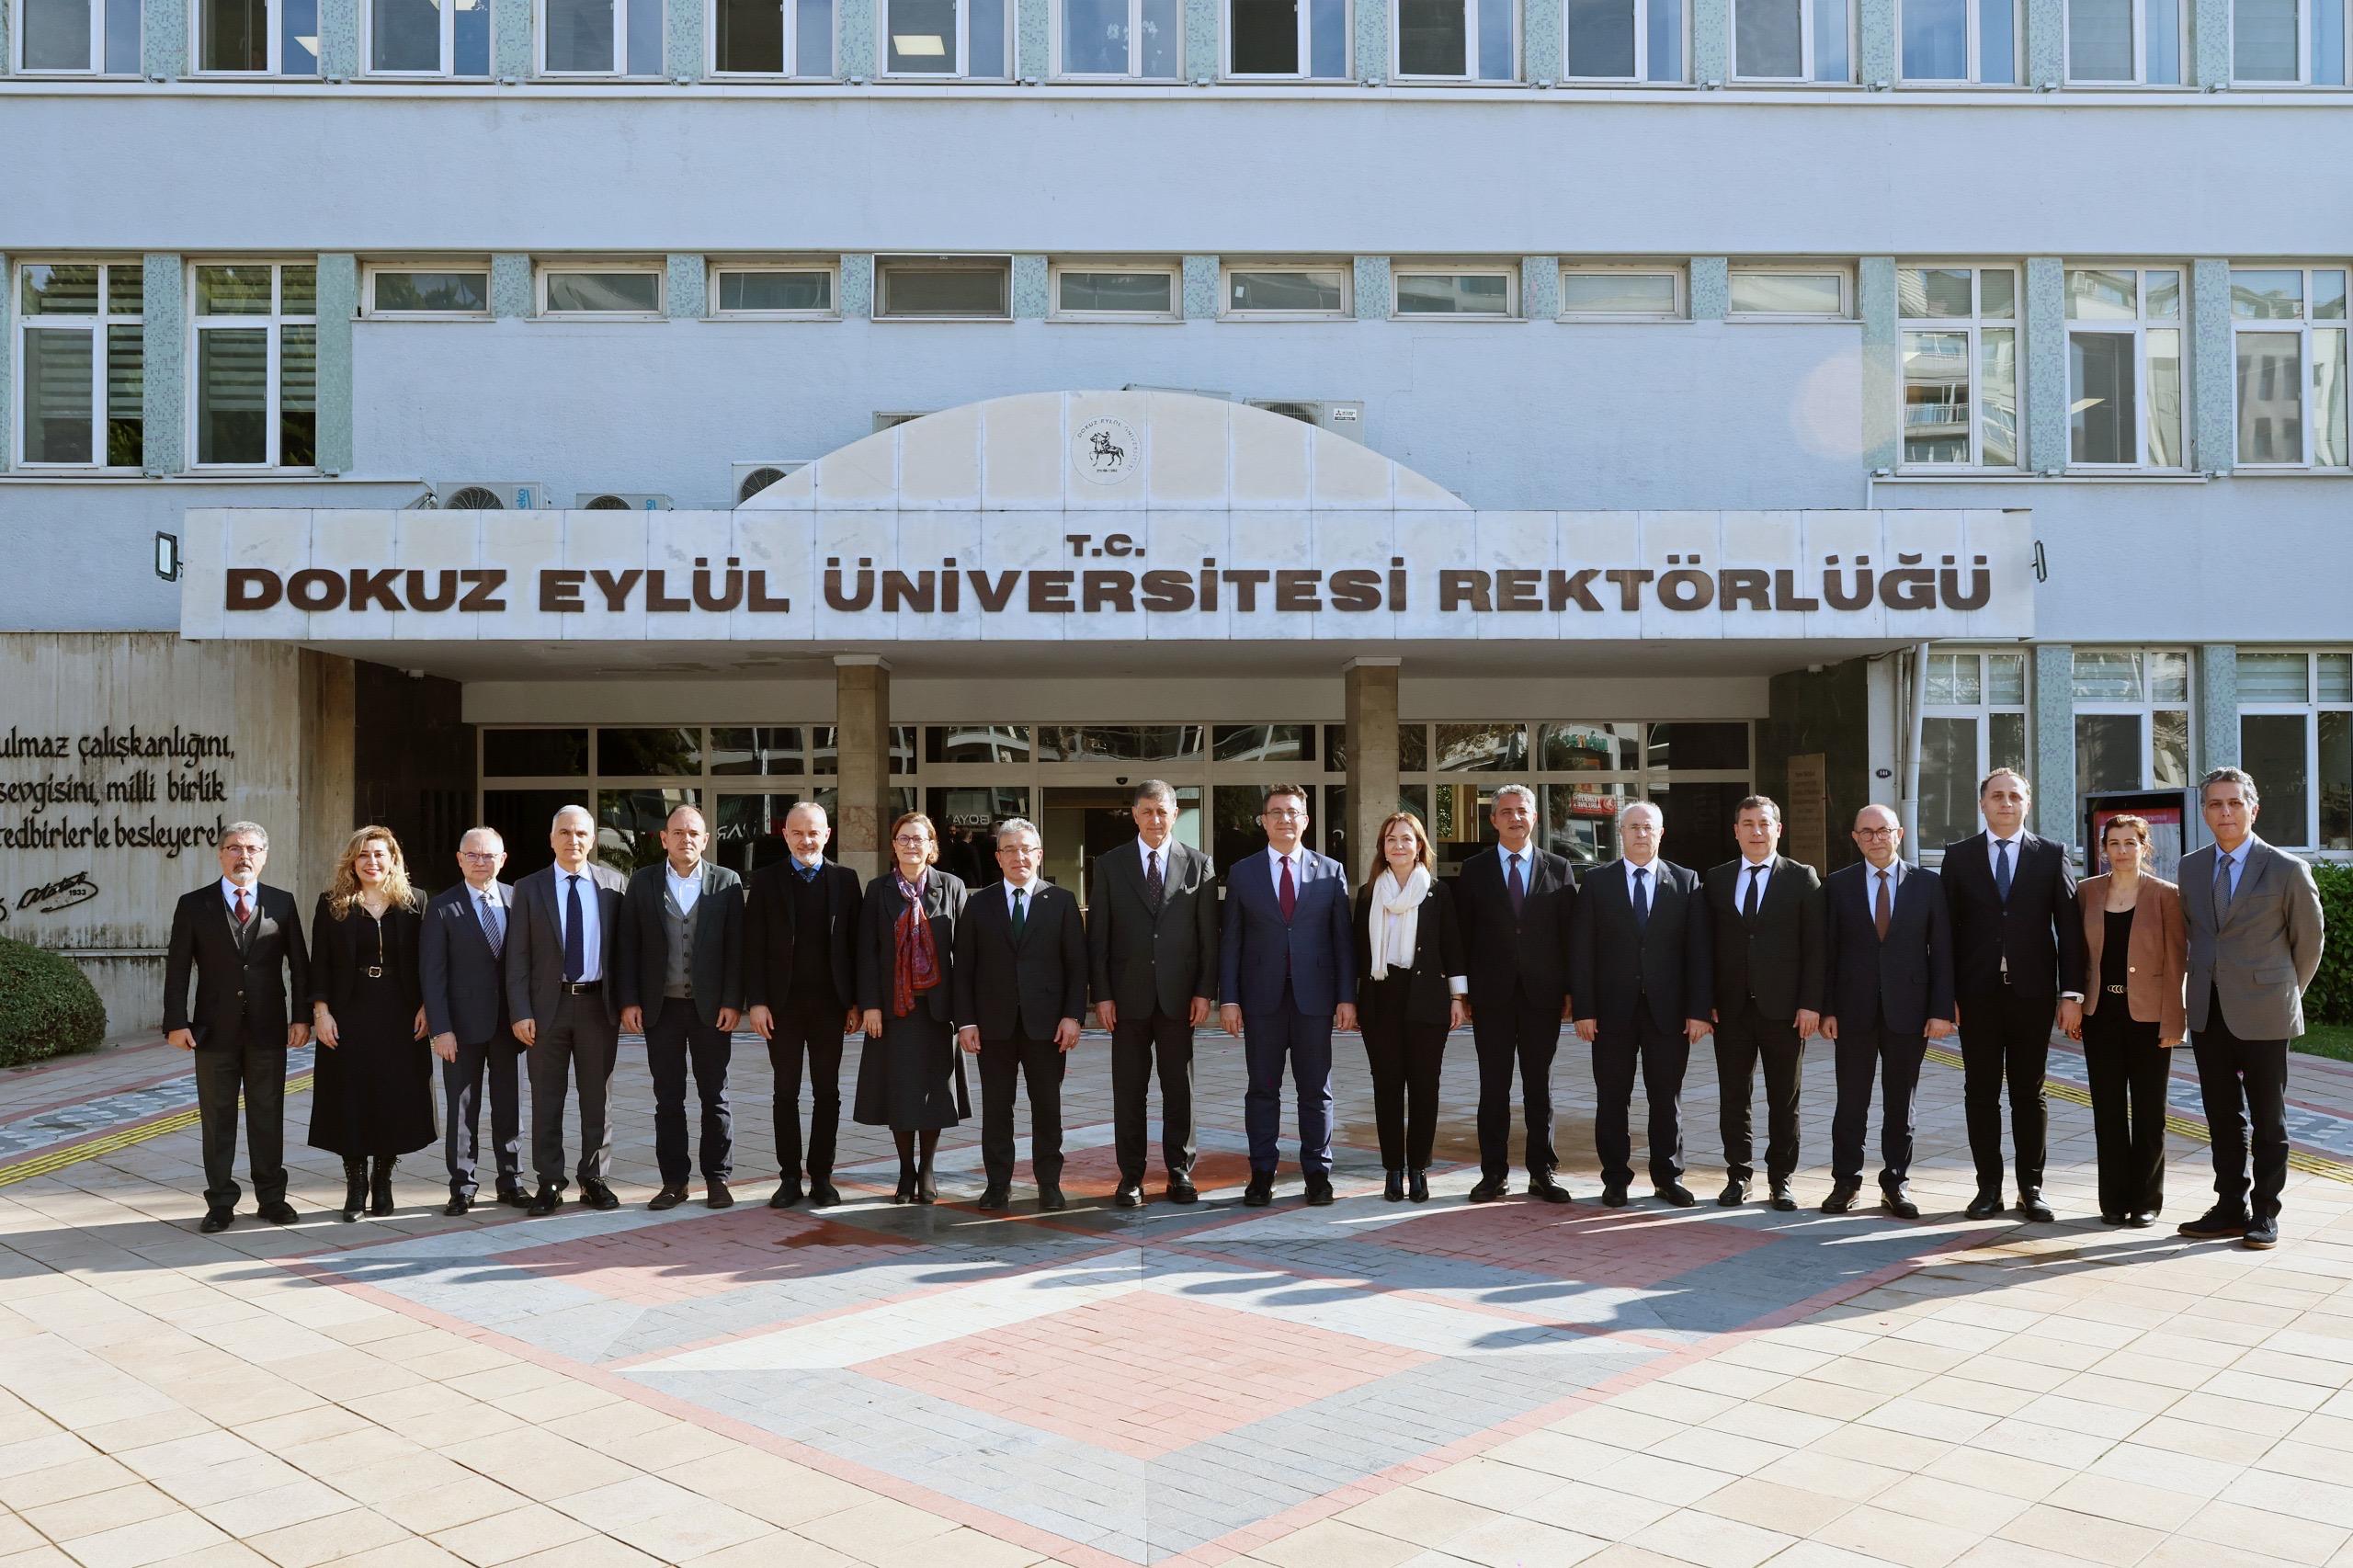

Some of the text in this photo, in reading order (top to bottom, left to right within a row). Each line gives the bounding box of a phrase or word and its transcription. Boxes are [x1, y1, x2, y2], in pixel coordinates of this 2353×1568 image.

[1077, 420, 1098, 438] DOKUZ
[1066, 534, 1145, 557] T.C.
[226, 553, 1991, 614] DOKUZ EYLÜL ÜNİVERSİTESİ REKTÖRLÜĞÜ
[107, 769, 156, 802] milli
[167, 769, 228, 802] birlik
